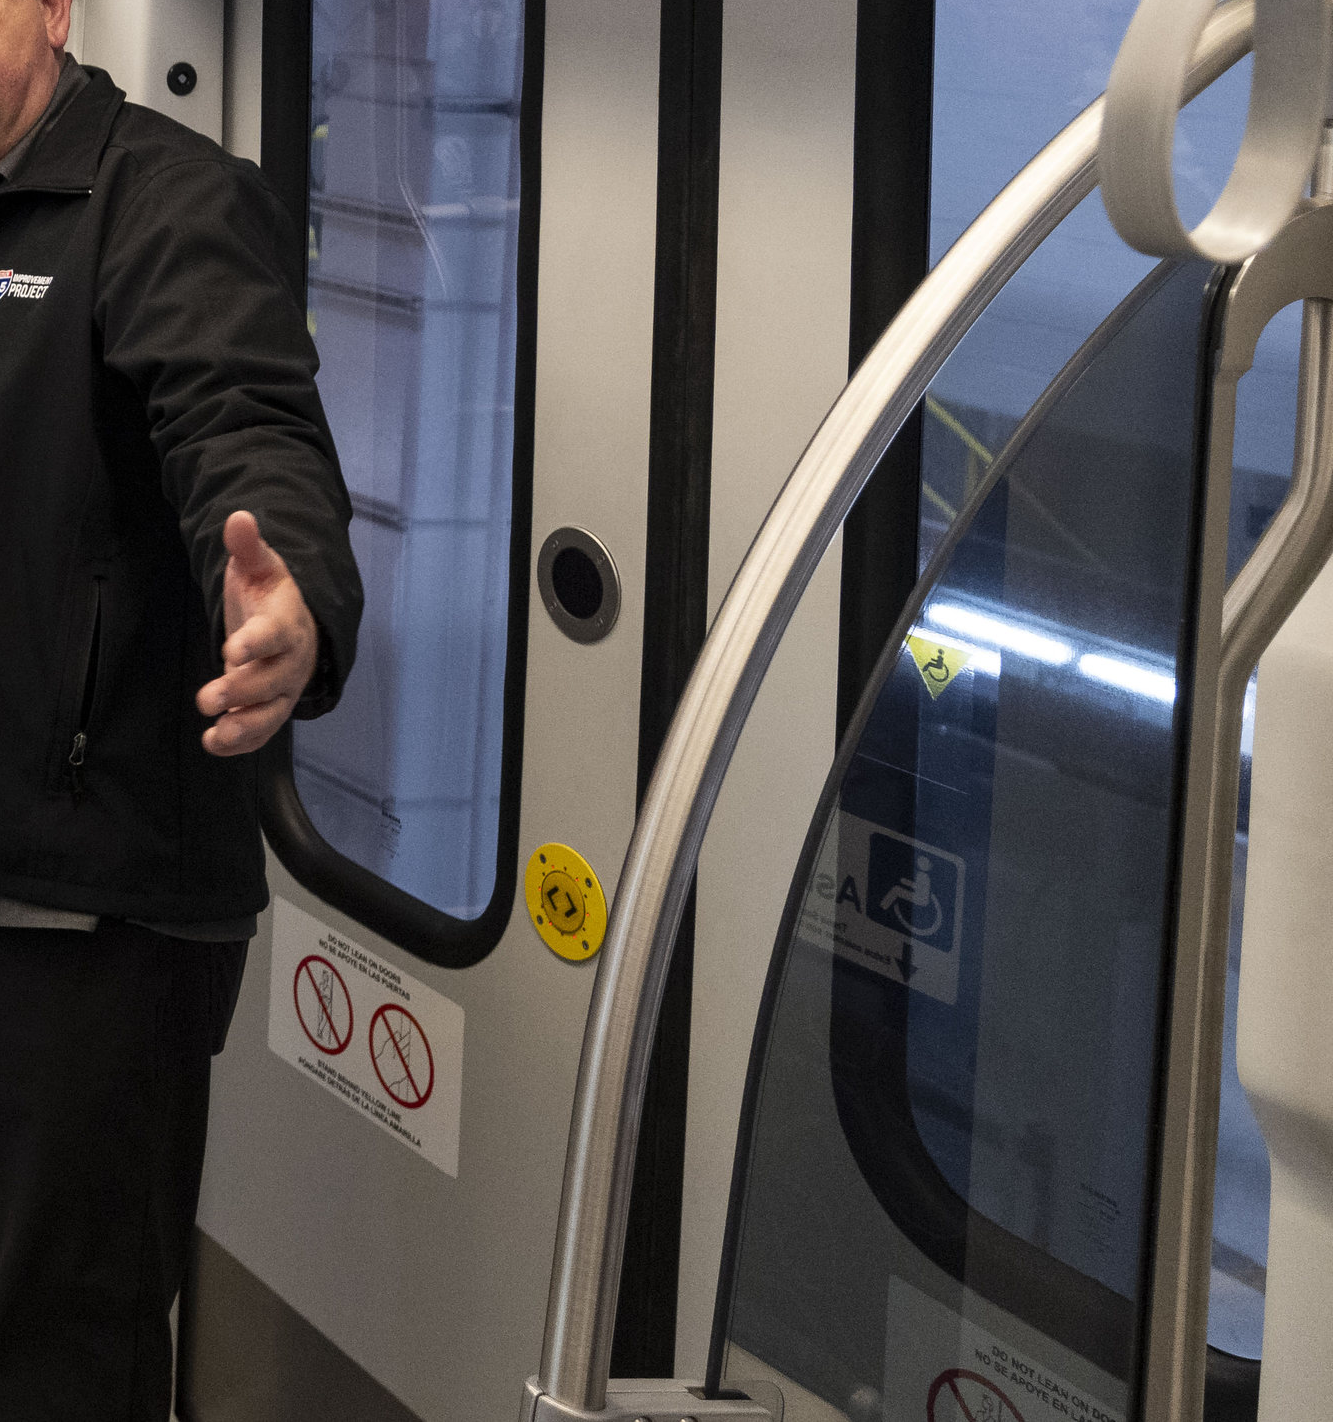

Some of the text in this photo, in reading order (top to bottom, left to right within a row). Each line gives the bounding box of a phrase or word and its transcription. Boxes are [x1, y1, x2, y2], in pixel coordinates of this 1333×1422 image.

[8, 284, 49, 299] PROJECT
[13, 274, 53, 285] IMPROVEMENT
[975, 1349, 991, 1365] NO
[994, 1362, 1008, 1377] SE
[1011, 1372, 1050, 1403] APOYE
[1052, 1398, 1069, 1415] EN
[992, 1346, 1008, 1362] DO
[1012, 1358, 1035, 1378] NOT
[1038, 1374, 1069, 1400] LEAN
[1072, 1396, 1089, 1413] ON
